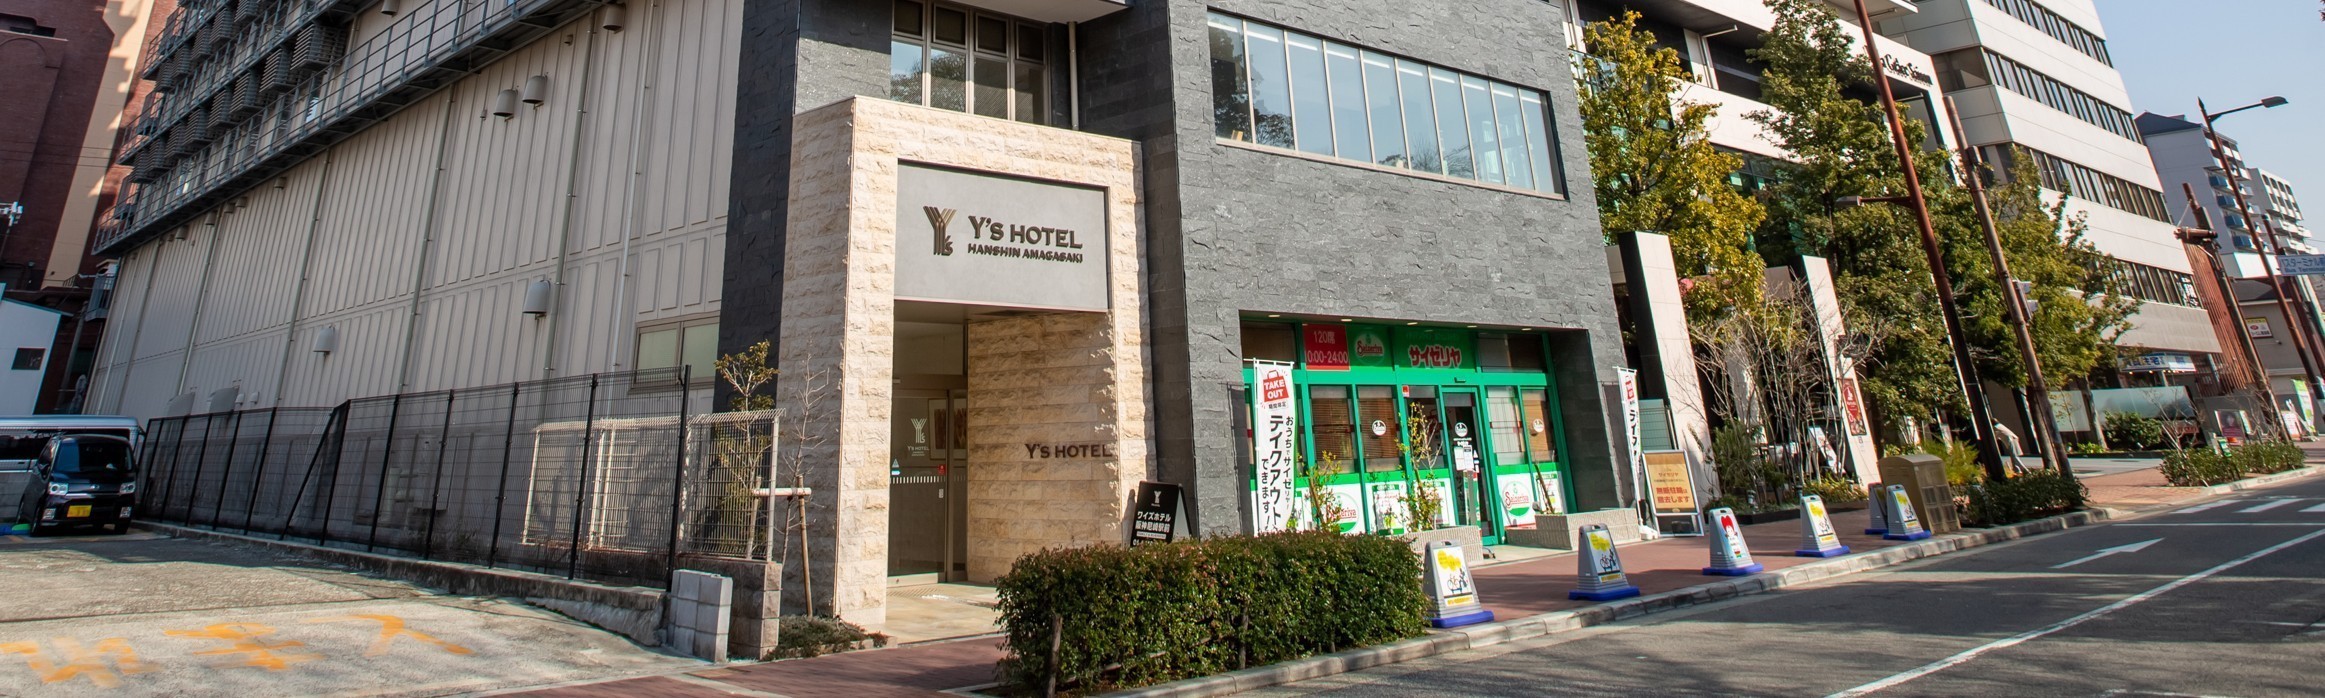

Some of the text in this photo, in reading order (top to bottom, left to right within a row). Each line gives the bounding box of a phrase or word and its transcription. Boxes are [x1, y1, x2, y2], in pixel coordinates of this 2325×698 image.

[968, 215, 1083, 249] Y'S HOTEL
[967, 243, 1083, 263] HANSHIN AMAGASAKI
[1408, 345, 1462, 369] サイゼリヤ
[1264, 379, 1285, 391] TAKE
[1267, 388, 1284, 399] OUT
[1025, 443, 1112, 459] Y'S HOTEL
[1137, 511, 1171, 522] ワイズホテル
